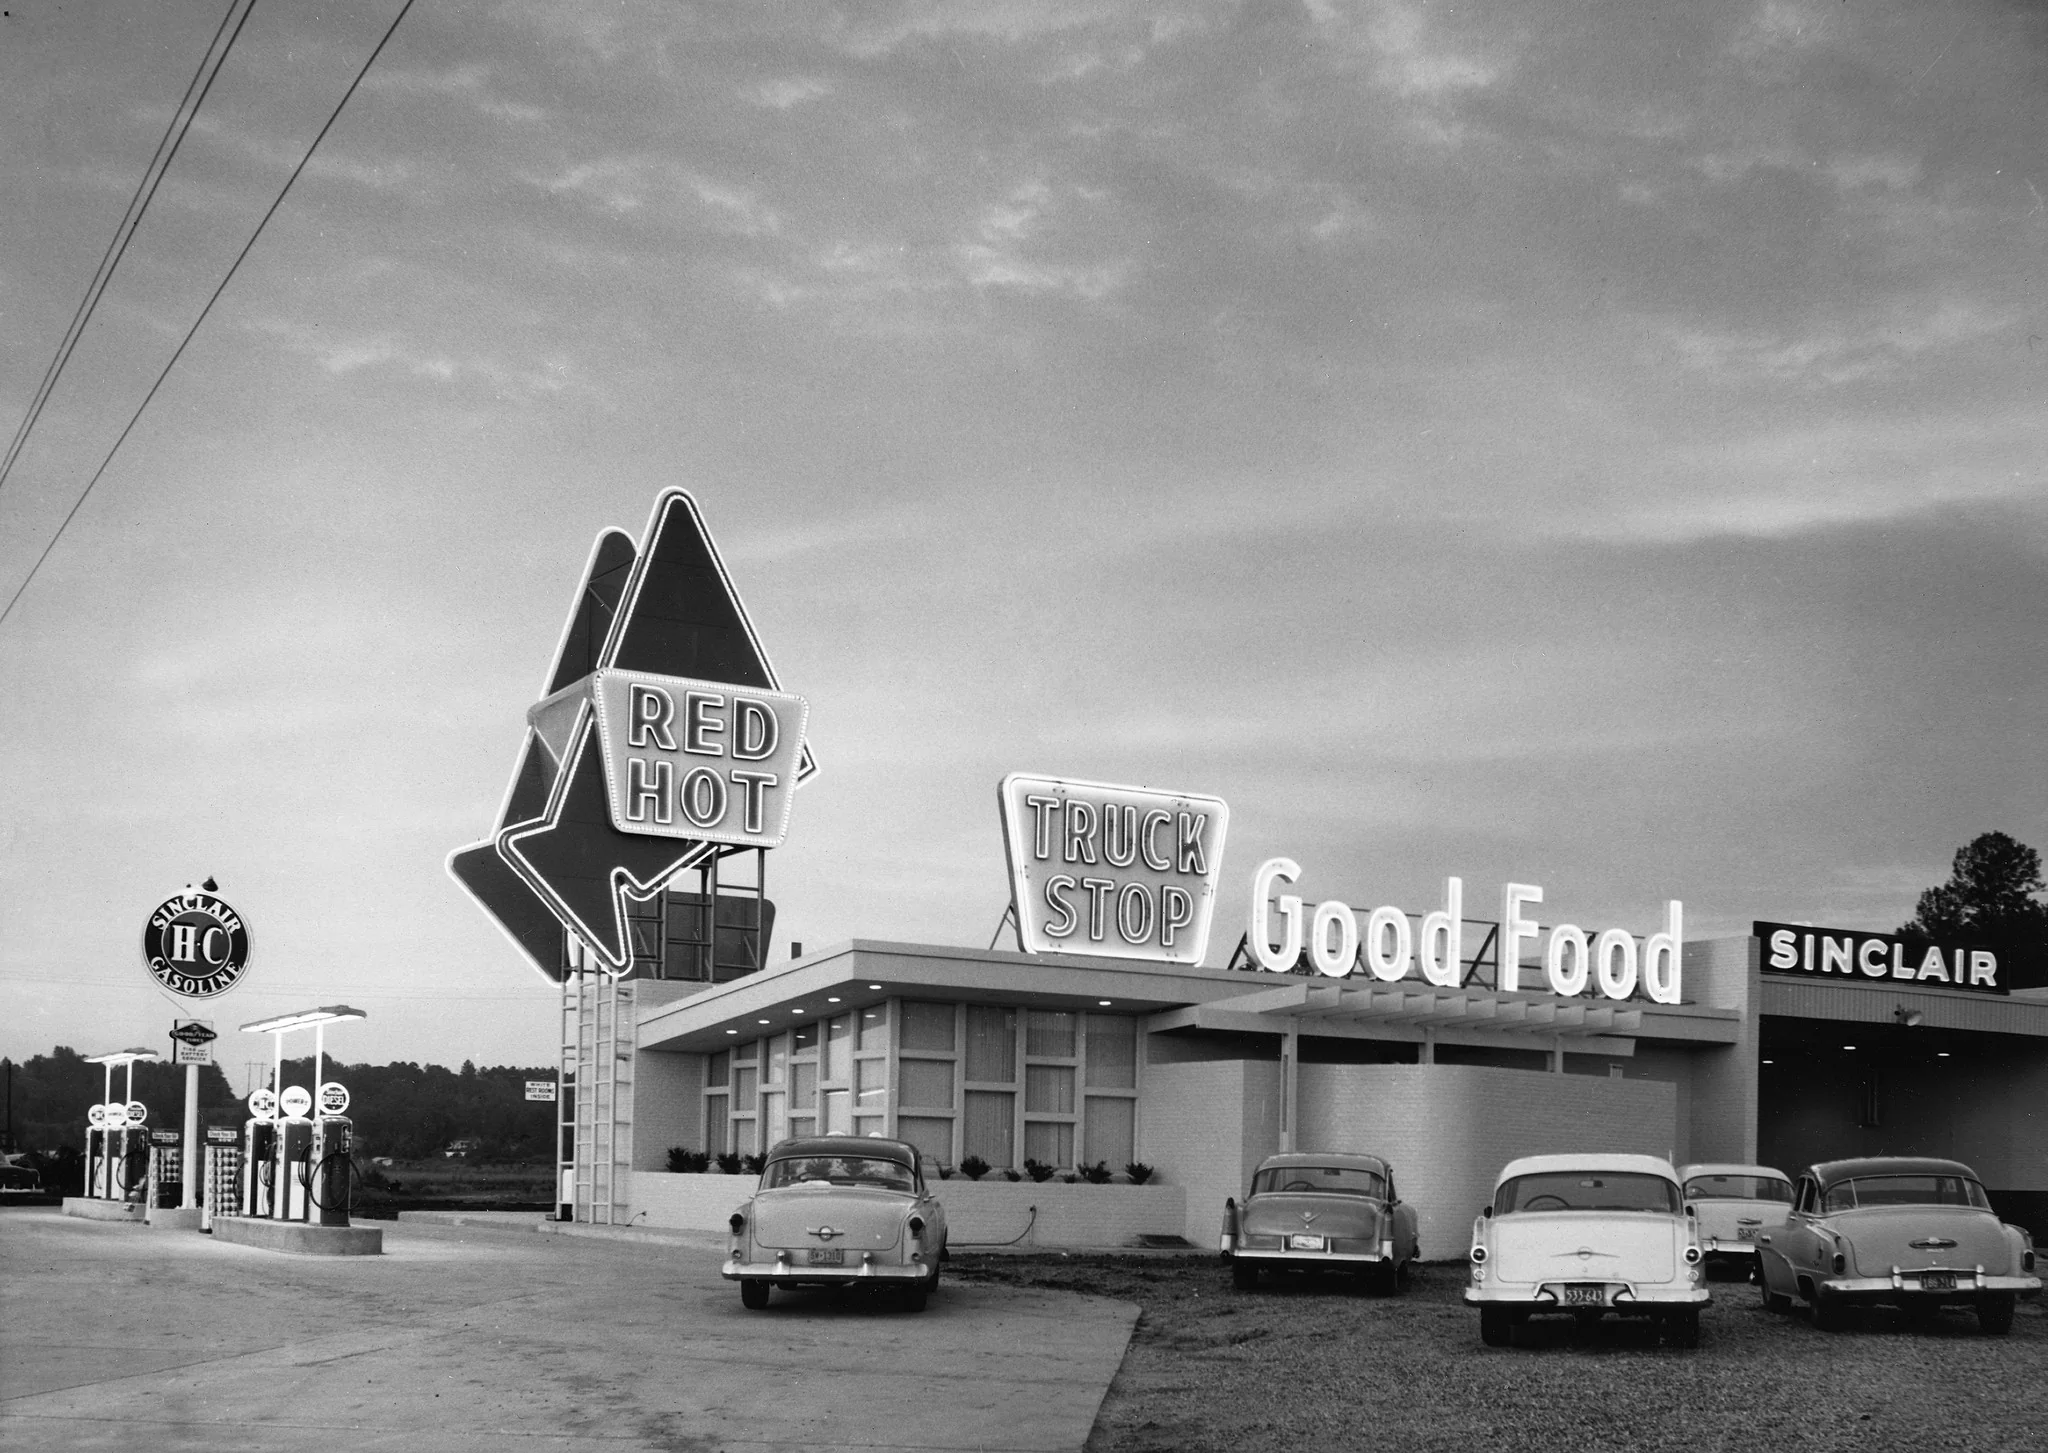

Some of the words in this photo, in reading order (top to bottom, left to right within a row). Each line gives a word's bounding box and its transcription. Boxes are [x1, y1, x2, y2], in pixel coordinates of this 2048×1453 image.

[628, 683, 779, 761] RED
[626, 757, 778, 834] HOT
[1026, 794, 1209, 875] TRUCK
[152, 895, 242, 934] SINCLAIR
[1044, 874, 1194, 947] STOP
[1248, 856, 1463, 988] Good
[1504, 881, 1684, 1005] Food
[151, 956, 242, 995] GASOLINE
[1769, 929, 1998, 987] SINCLAIR
[322, 1095, 344, 1105] DIESEL
